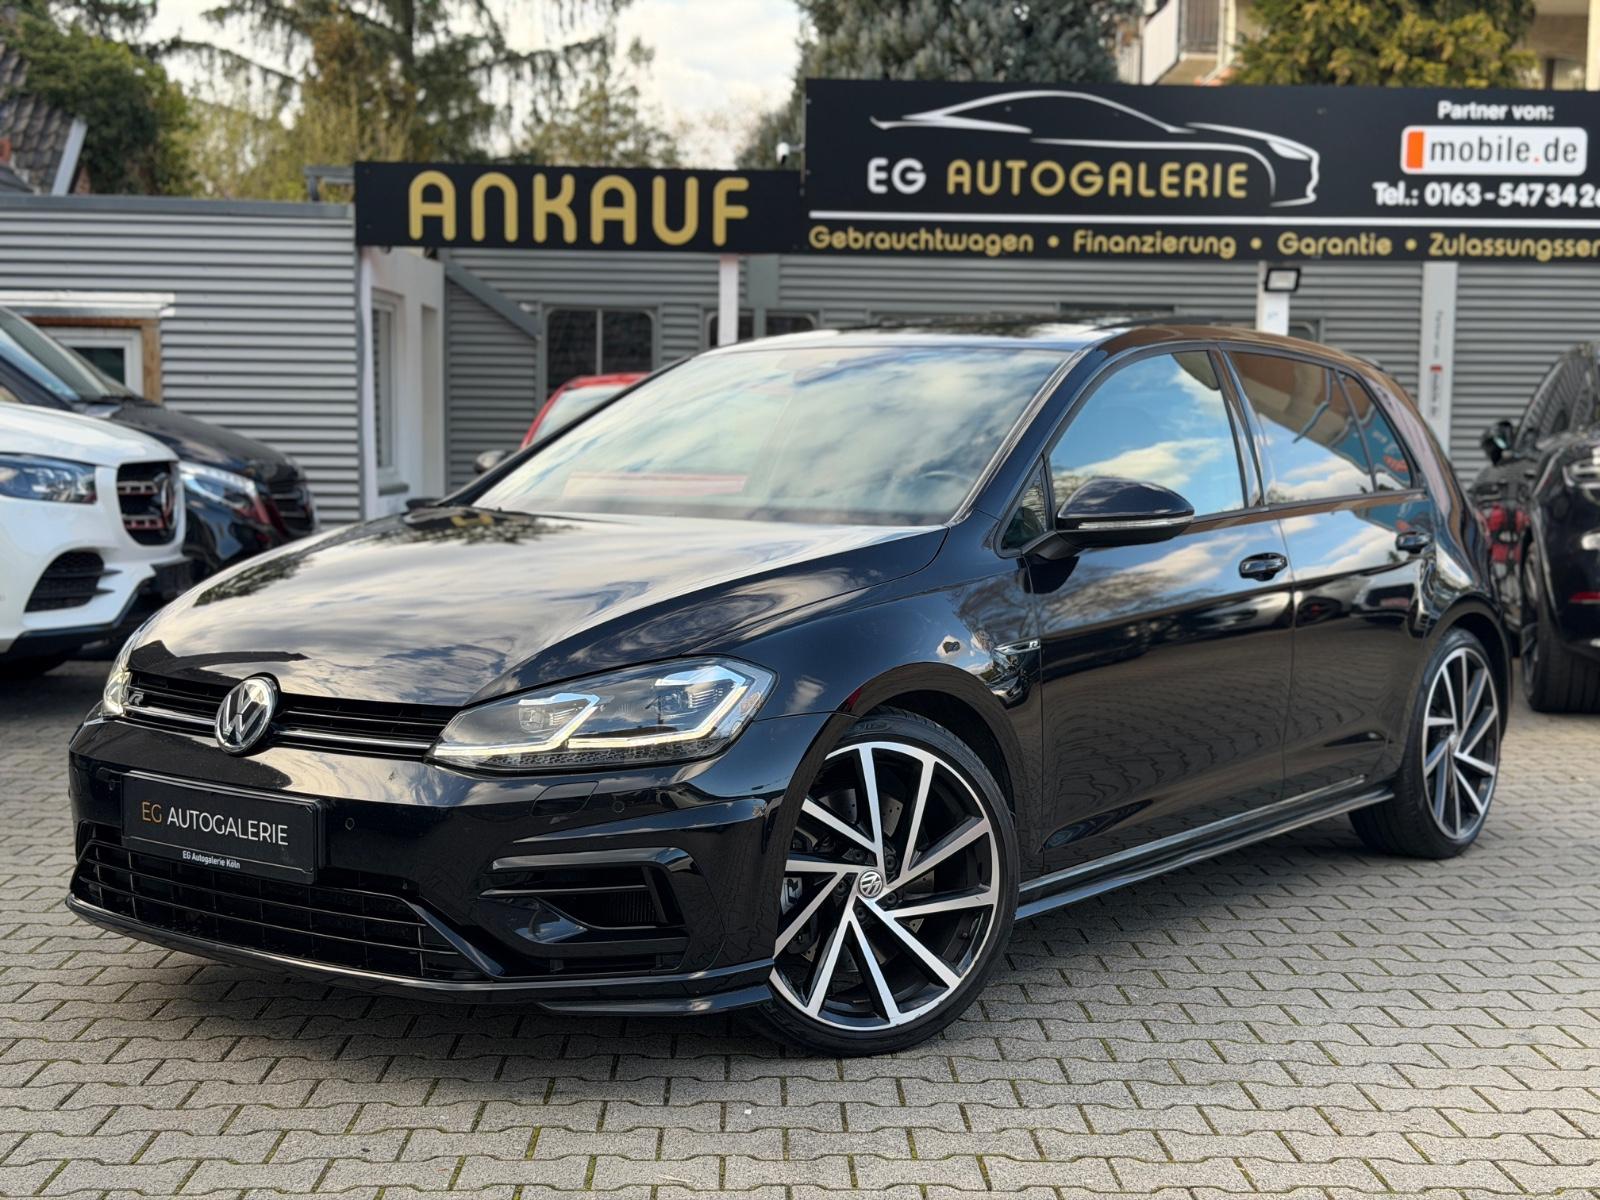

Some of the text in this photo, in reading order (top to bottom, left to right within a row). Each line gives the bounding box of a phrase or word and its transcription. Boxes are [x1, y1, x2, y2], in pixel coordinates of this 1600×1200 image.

[1437, 100, 1554, 120] Partner von:
[1430, 135, 1577, 162] mobile.de
[867, 157, 1248, 199] EG AUTOGALERIE
[1372, 181, 1419, 206] Tel.:
[408, 170, 750, 246] ANKAUF
[808, 225, 1034, 257] Gebrauchtwagen
[1073, 229, 1237, 260] Finanzierung
[1277, 231, 1393, 256] Garantie
[141, 801, 289, 846] EG AUTOGALERIE
[182, 850, 241, 869] EG Autogalerie Köln
